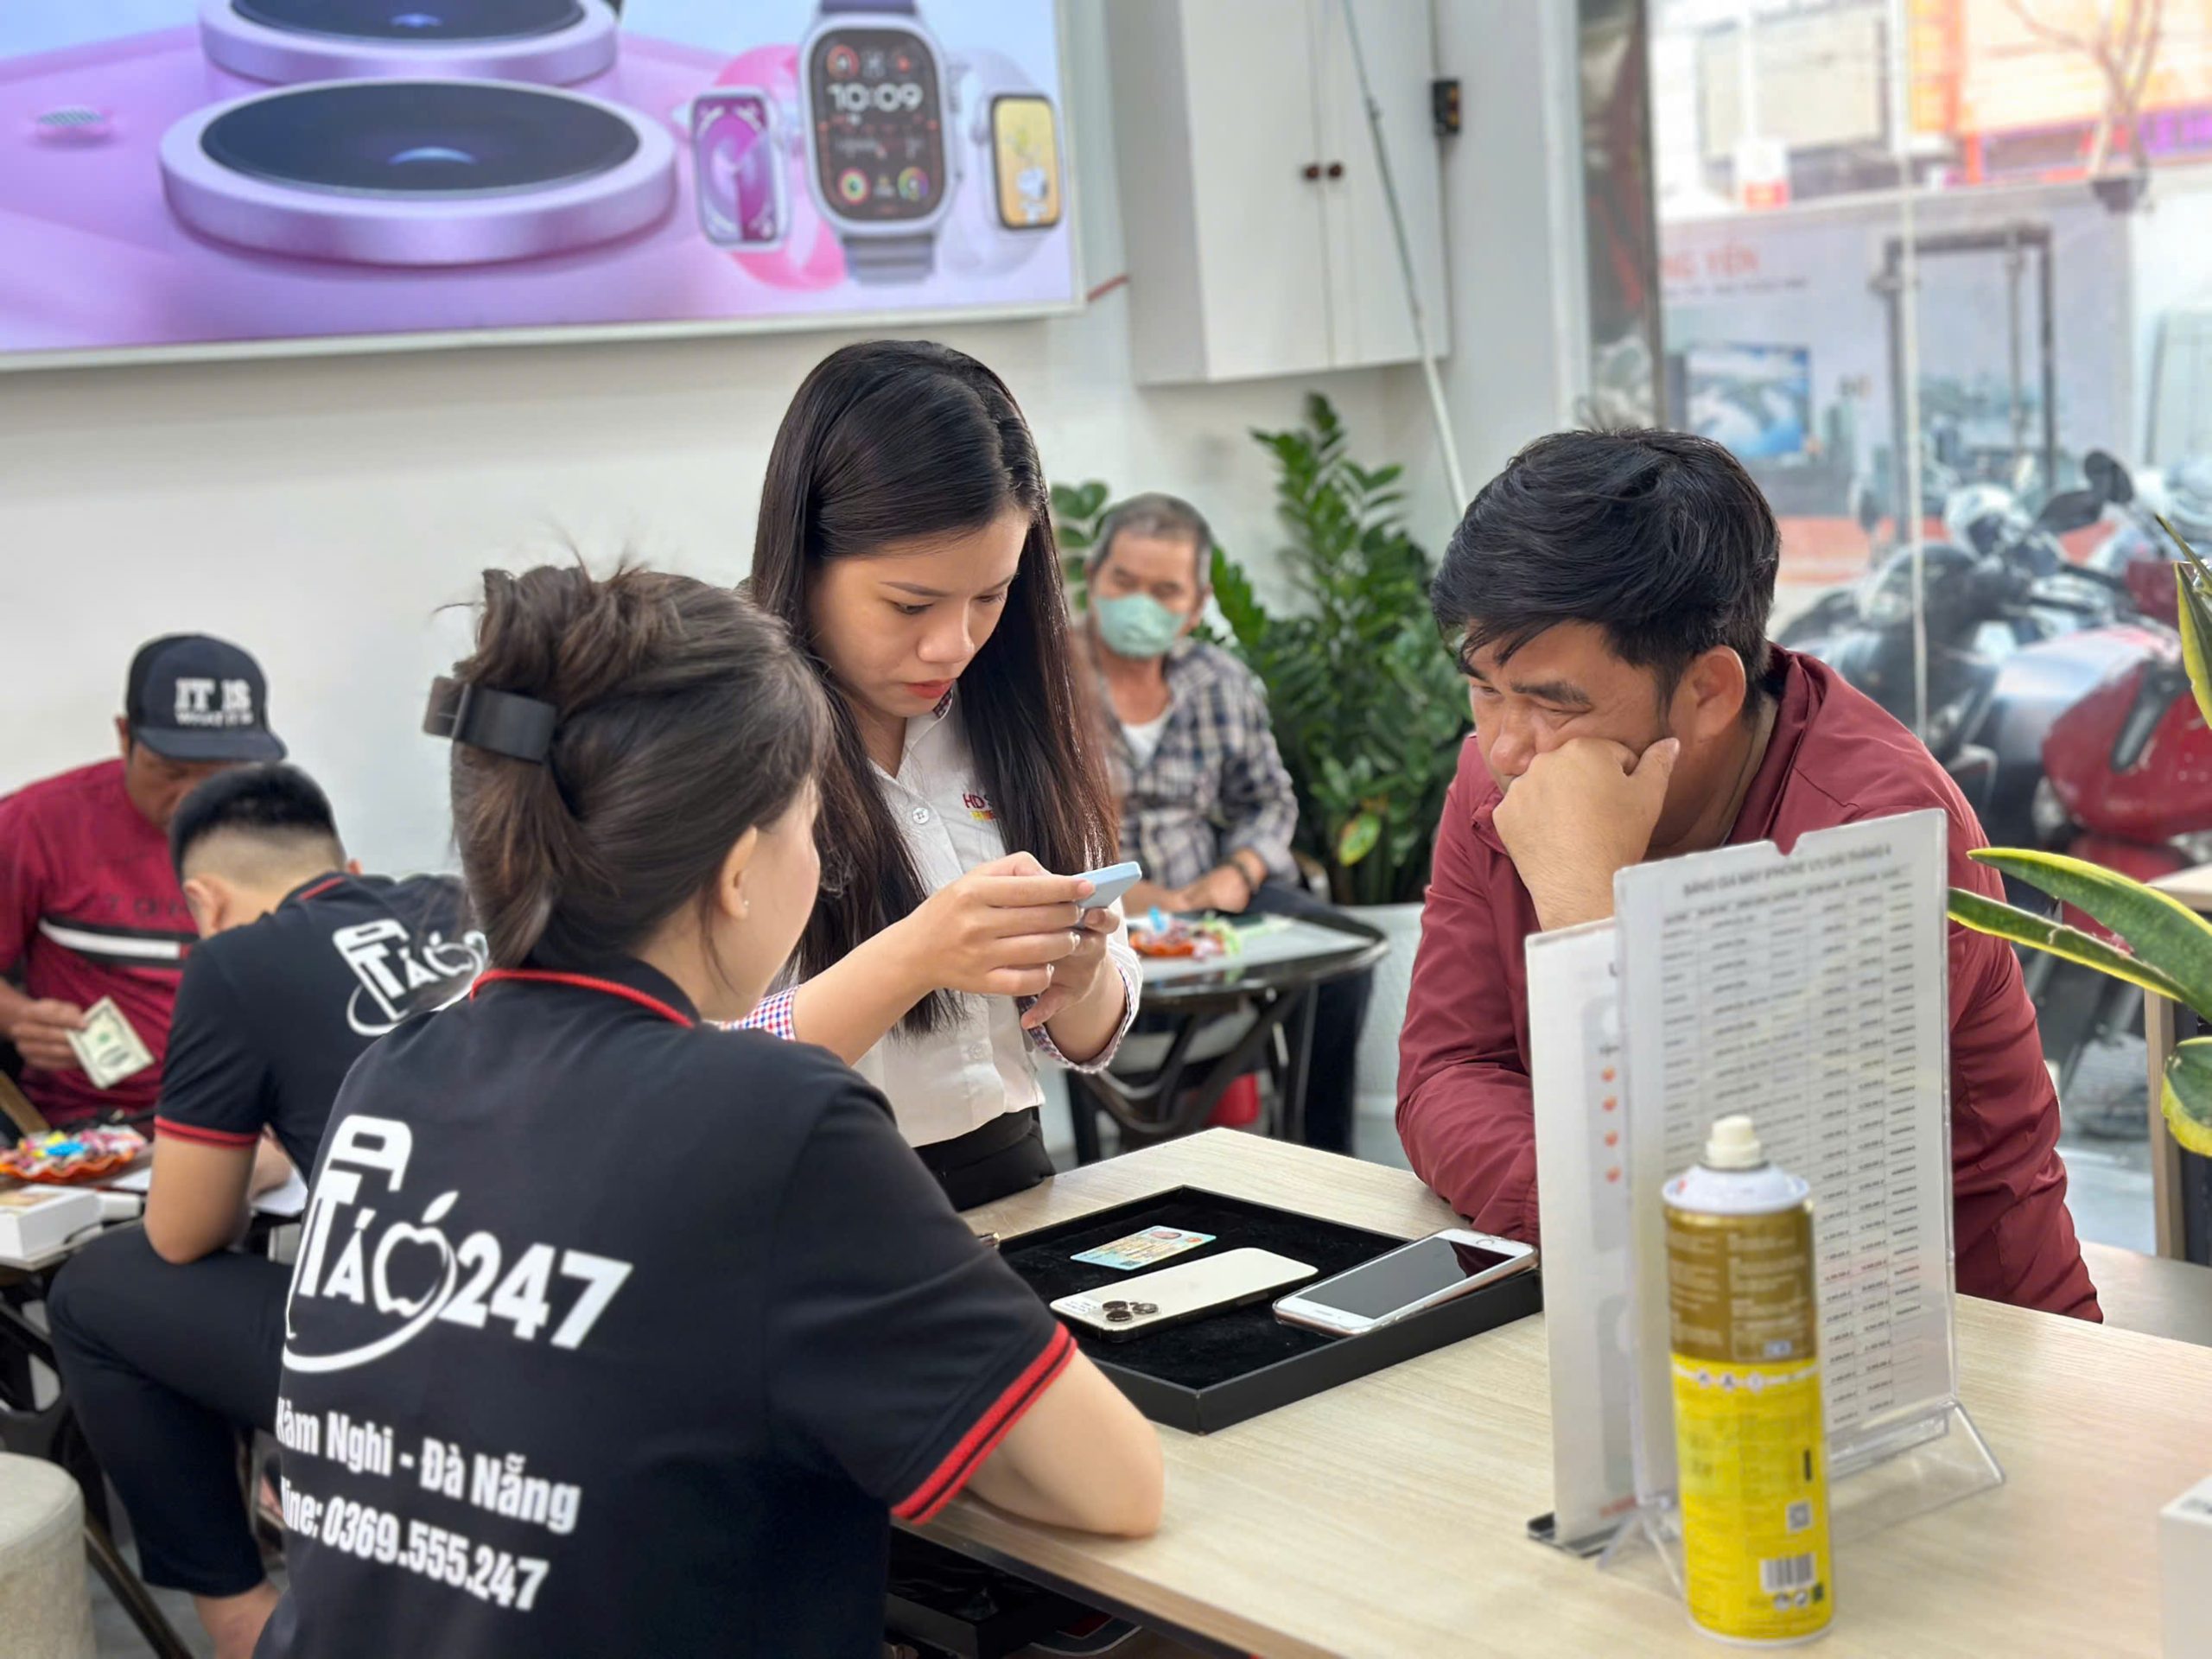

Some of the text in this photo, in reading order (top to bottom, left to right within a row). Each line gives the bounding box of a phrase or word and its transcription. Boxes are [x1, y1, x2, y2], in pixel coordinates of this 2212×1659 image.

[828, 82, 923, 112] 10:09
[175, 677, 252, 713] IT IS
[327, 1410, 393, 1477] Nghi
[420, 1437, 465, 1501] Đà
[471, 1452, 582, 1534] Nẵng
[281, 1476, 550, 1611] line: 0369.555.247
